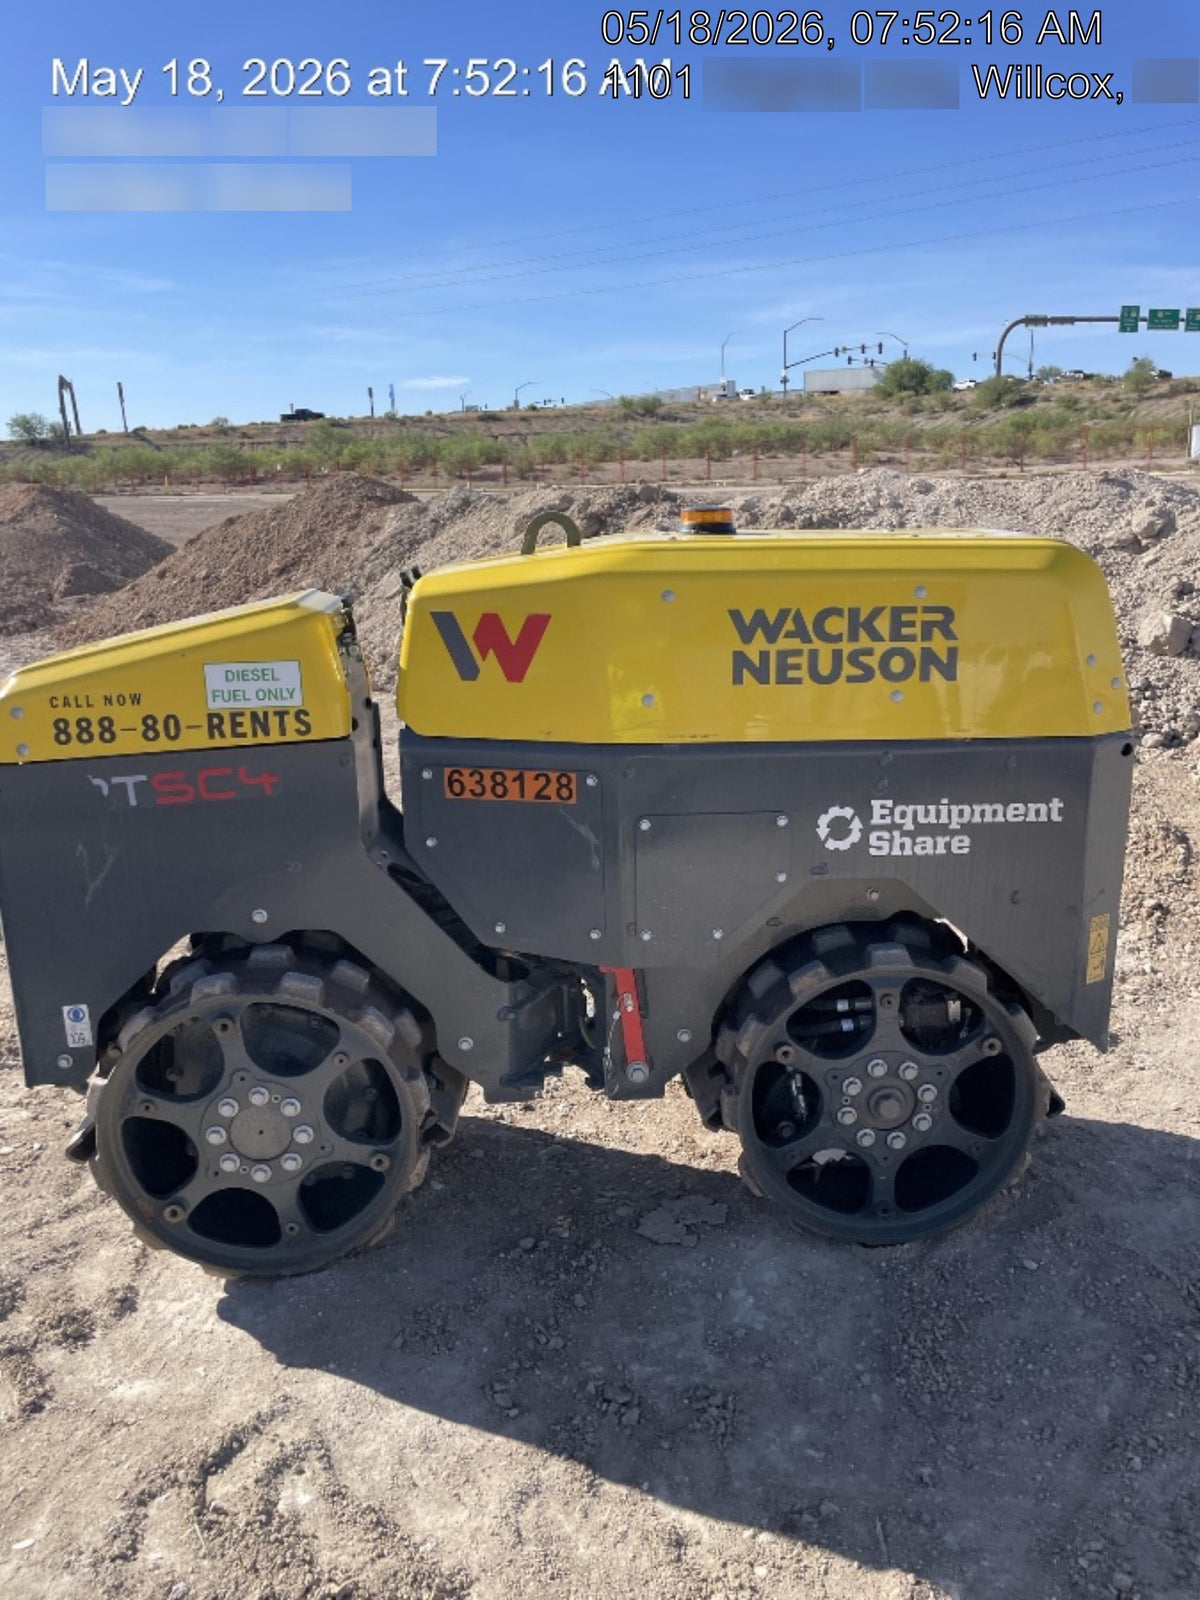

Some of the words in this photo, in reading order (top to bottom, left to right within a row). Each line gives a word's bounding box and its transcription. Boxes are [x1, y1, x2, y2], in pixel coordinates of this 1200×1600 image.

[728, 605, 960, 645] WACKER
[225, 667, 280, 683] DIESEL
[732, 646, 959, 686] NEUSON
[49, 695, 95, 709] CALL
[103, 692, 143, 707] NOW
[212, 689, 252, 704] FUEL
[255, 687, 296, 703] ONLY
[447, 769, 574, 800] 638128
[870, 798, 1065, 831] Equipment
[868, 830, 971, 857] Share
